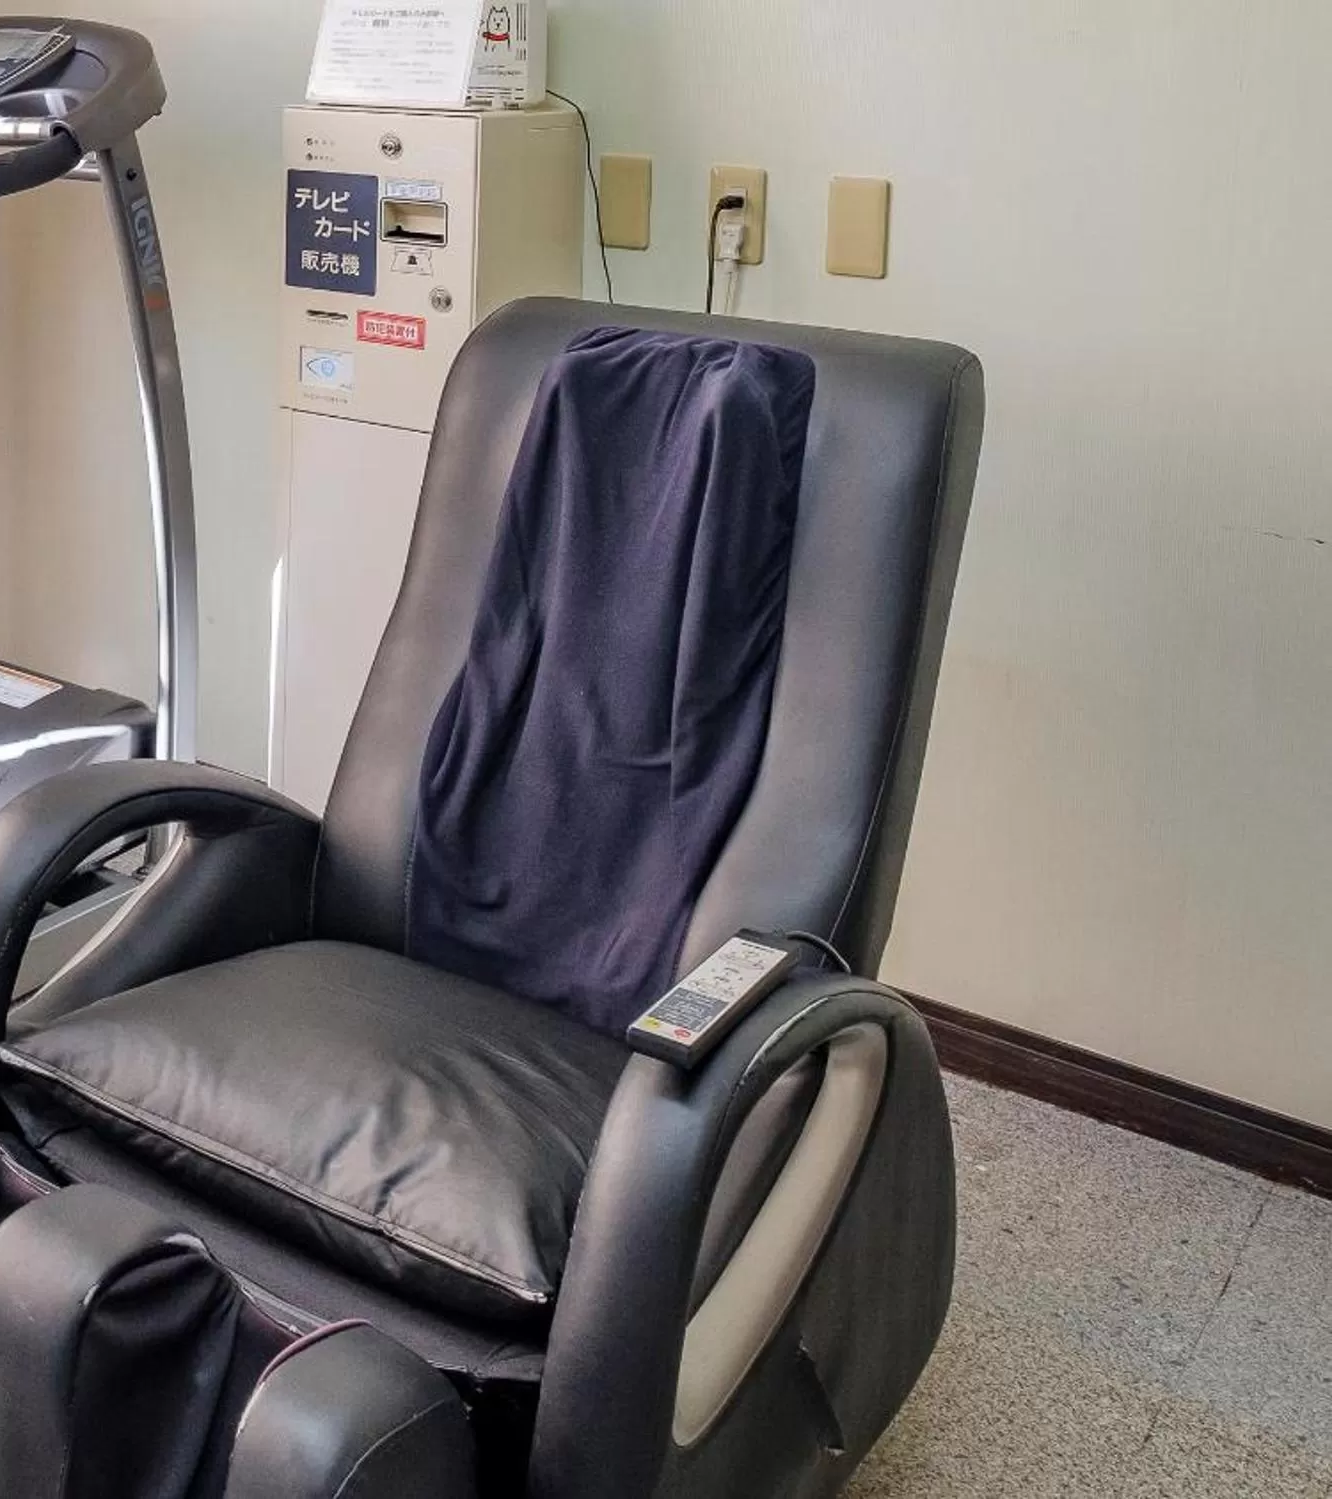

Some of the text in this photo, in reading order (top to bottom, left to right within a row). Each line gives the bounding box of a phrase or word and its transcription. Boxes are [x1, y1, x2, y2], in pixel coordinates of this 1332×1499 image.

[294, 188, 350, 213] テレビ
[315, 216, 370, 242] カード
[301, 250, 360, 276] 販売機
